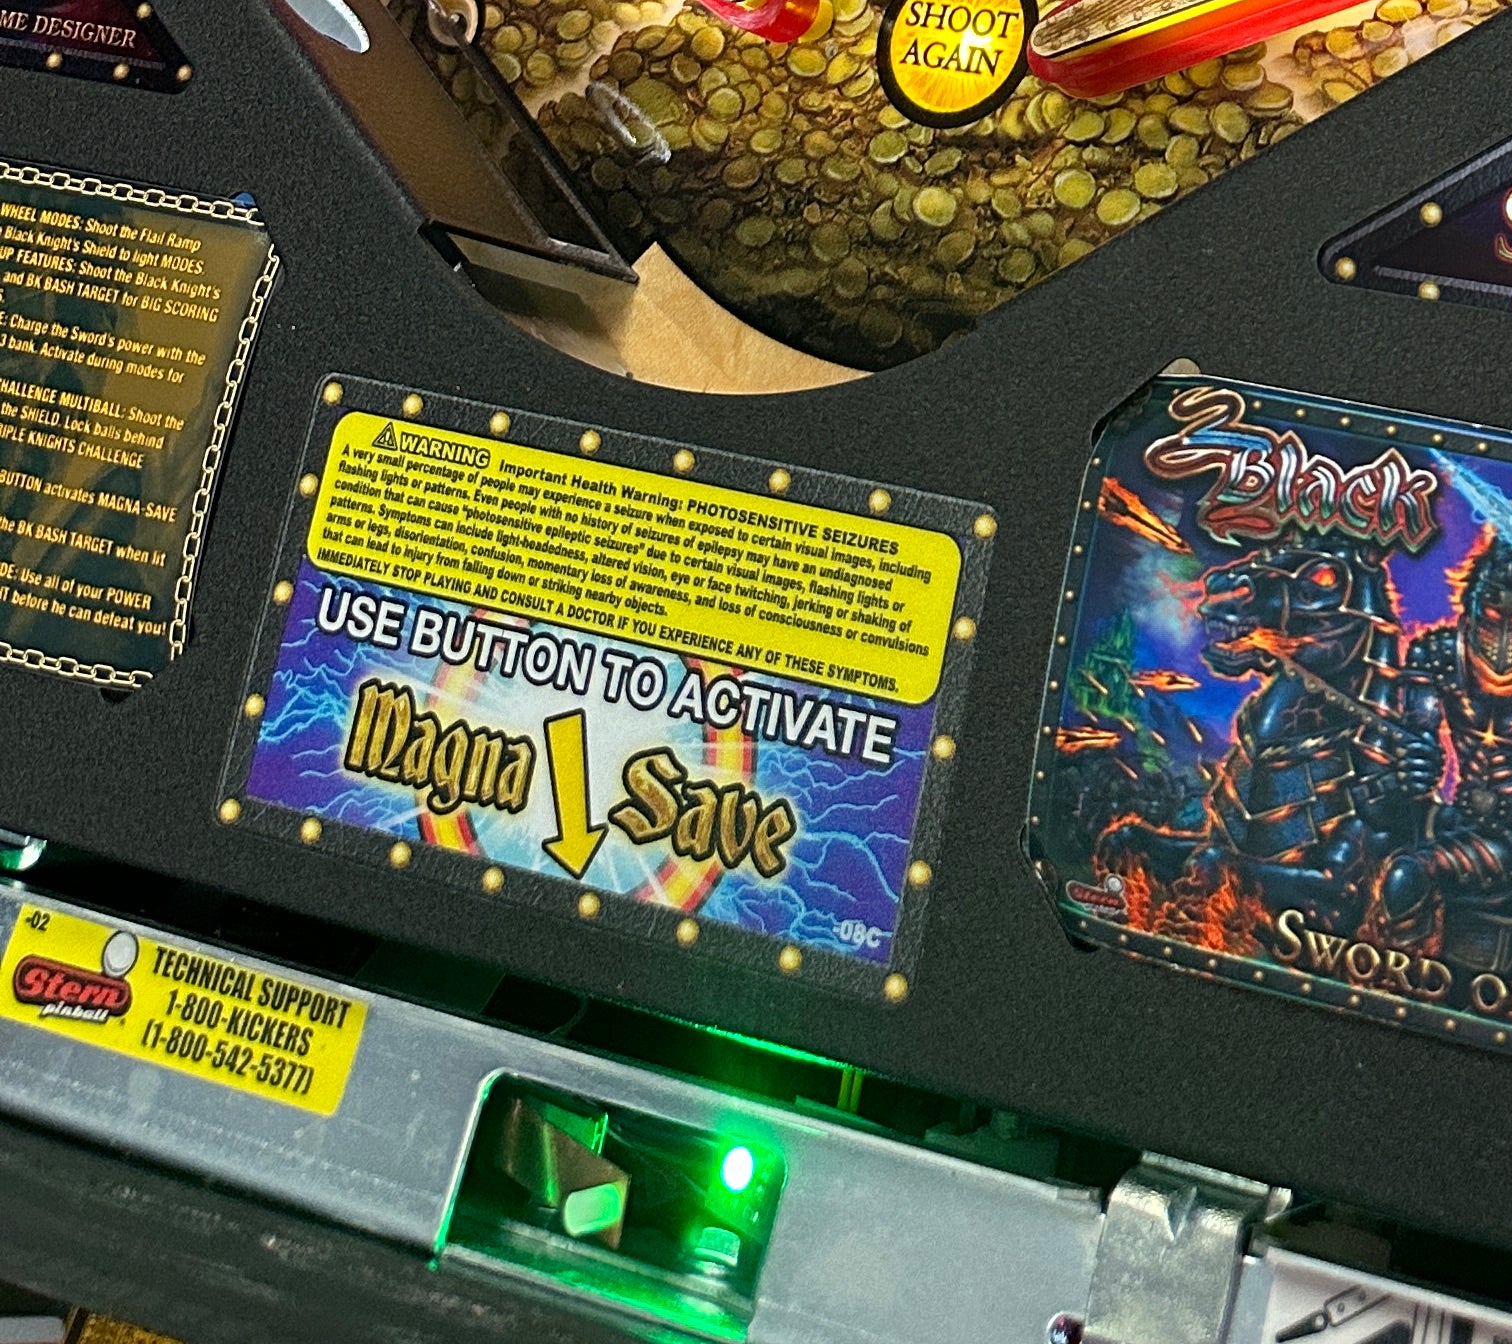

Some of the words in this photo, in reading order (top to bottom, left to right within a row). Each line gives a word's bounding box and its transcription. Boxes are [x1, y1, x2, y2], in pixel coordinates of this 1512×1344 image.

[32, 14, 137, 48] DESIGNER
[904, 0, 1020, 40] SHOOT
[899, 42, 1004, 78] AGAIN
[3, 225, 34, 243] Black
[35, 231, 80, 252] Knight's
[81, 239, 118, 259] Shield
[118, 247, 131, 261] to
[131, 249, 159, 267] light
[84, 217, 118, 237] Shoot
[118, 224, 138, 240] the
[138, 227, 165, 244] Flail
[165, 232, 201, 253] Ramp
[2, 271, 24, 285] and
[25, 272, 42, 289] BK
[42, 276, 75, 295] BASH
[76, 281, 120, 303] TARGET
[120, 291, 138, 307] for
[140, 295, 162, 311] BIG
[162, 299, 219, 322] SCORING
[77, 260, 113, 280] Shoot
[113, 267, 133, 283] the
[134, 271, 167, 290] Black
[169, 278, 221, 299] Knight's
[9, 313, 49, 335] Charge
[50, 322, 69, 338] the
[69, 325, 115, 348] Sword's
[115, 338, 154, 355] power
[155, 346, 183, 360] with
[184, 349, 206, 365] the
[38, 341, 85, 363] Activate
[85, 351, 124, 374] during
[124, 361, 164, 379] modes
[166, 367, 184, 383] for
[0, 401, 18, 417] the
[63, 414, 90, 434] Lock
[92, 421, 121, 440] balls
[122, 427, 164, 449] behind
[127, 406, 162, 426] Shoot
[163, 414, 184, 430] the
[26, 430, 76, 453] KNIGHTS
[77, 441, 144, 469] CHALLENGE
[1143, 385, 1442, 553] Black
[42, 482, 95, 504] activates
[96, 491, 177, 522] MAGNA-SAVE
[399, 430, 491, 470] WARNING
[498, 458, 567, 485] Important
[570, 474, 617, 496] Health
[620, 484, 683, 512] Warning:
[686, 498, 819, 538] PHOTOSENSITIVE
[821, 526, 899, 555] SEIZURES
[16, 519, 33, 537] BK
[34, 523, 67, 544] BASH
[69, 531, 113, 555] TARGET
[115, 544, 149, 563] when
[151, 550, 166, 567] lit
[19, 567, 42, 585] Use
[43, 574, 60, 589] all
[60, 578, 75, 593] of
[75, 583, 104, 599] your
[105, 586, 151, 610] POWER
[10, 589, 49, 611] before
[50, 598, 66, 615] he
[67, 605, 91, 621] can
[92, 609, 135, 630] defeat
[136, 620, 166, 635] you!
[316, 546, 390, 575] IMMEDIATELY
[391, 563, 422, 582] STOP
[422, 571, 472, 594] PLAYING
[472, 582, 498, 600] AND
[499, 588, 554, 613] CONSULT
[554, 601, 564, 616] A
[566, 603, 615, 628] DOCTOR
[616, 615, 629, 630] IF
[632, 618, 657, 637] YOU
[658, 624, 734, 655] EXPERIENCE
[734, 643, 763, 661] ANY
[764, 649, 782, 665] OF
[784, 653, 825, 676] THESE
[826, 663, 899, 693] SYMPTOMS.
[316, 588, 405, 646] USE
[408, 606, 595, 695] BUTTON
[600, 653, 666, 706] TO
[669, 672, 897, 765] ACTIVATE
[344, 679, 537, 813] Magna
[607, 748, 799, 879] Save
[20, 963, 128, 1007] Stern
[152, 945, 256, 1006] TECHNICAL
[257, 979, 349, 1030] SUPPORT
[41, 998, 110, 1025] pinball
[165, 988, 313, 1058] 1-800-KICKERS
[140, 1017, 315, 1097] (1-800-542-5377)
